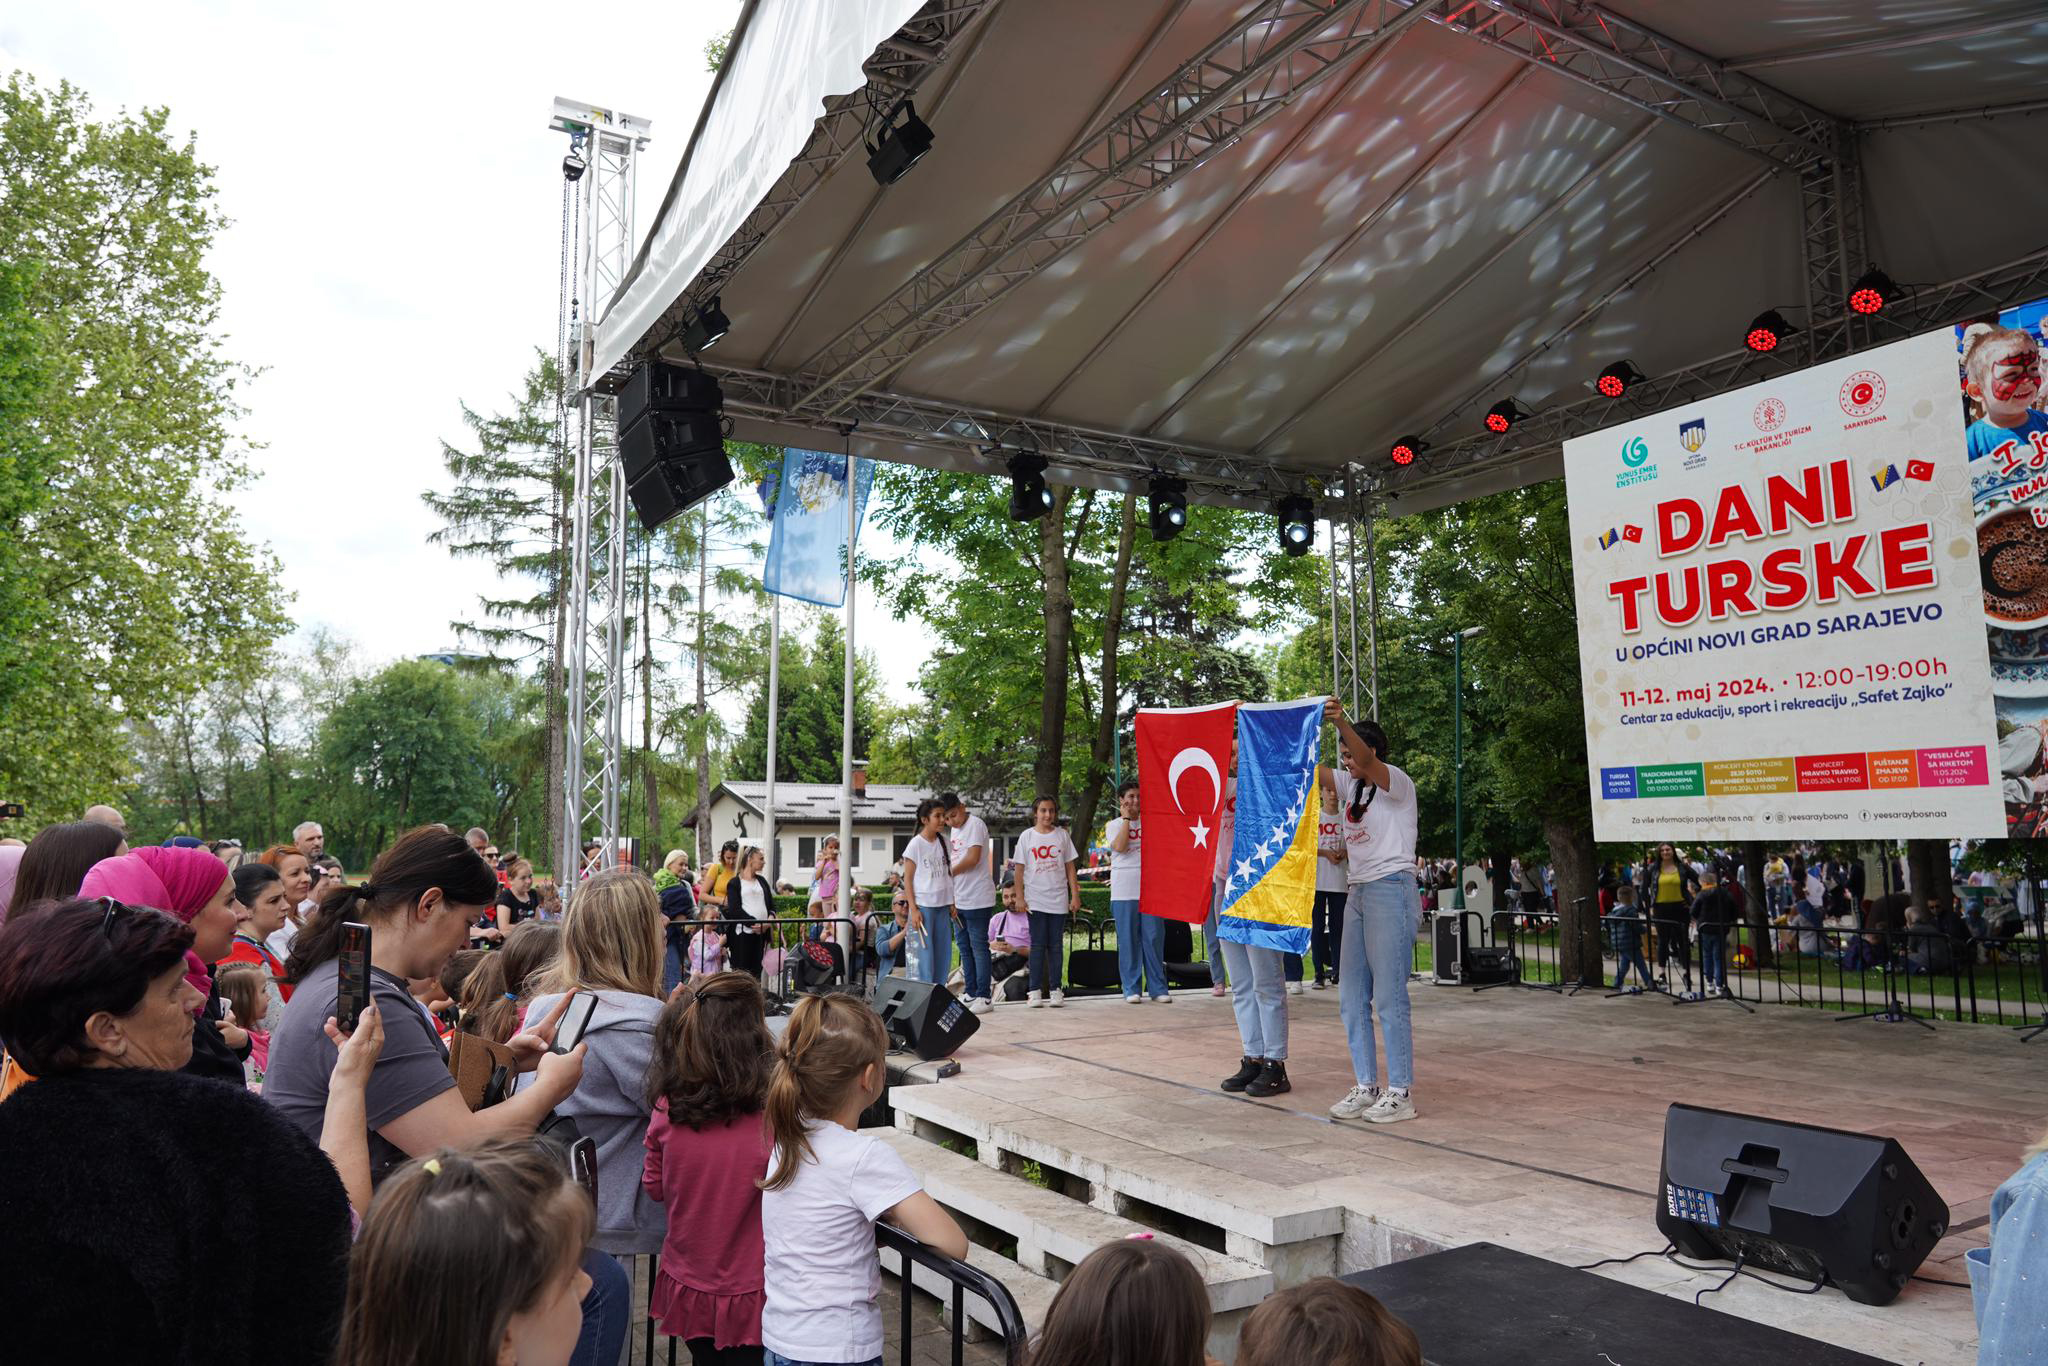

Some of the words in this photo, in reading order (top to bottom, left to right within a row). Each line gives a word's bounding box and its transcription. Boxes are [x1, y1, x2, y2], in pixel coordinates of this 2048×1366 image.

[1843, 414, 1887, 430] SARAYBOSNA
[1746, 435, 1773, 448] KÜLTÜR
[1774, 432, 1783, 440] VE
[1754, 438, 1792, 454] BAKANLIĞI
[1616, 468, 1638, 481] YUNUS
[1640, 464, 1657, 476] EMRE
[1656, 458, 1854, 556] DANI
[1608, 522, 1936, 632] TURSKE
[1616, 647, 1628, 662] U
[1632, 636, 1693, 660] OPĆINI
[1698, 632, 1746, 652] NOVI
[1751, 622, 1812, 644] GRAD
[1816, 602, 1943, 636] SARAJEVO
[1620, 688, 1670, 707] 11-12.
[1677, 684, 1711, 704] maj
[1718, 677, 1774, 698] 2024.
[1620, 712, 1658, 726] Centar
[1660, 712, 1673, 723] za
[1676, 704, 1735, 721] edukaciju,
[1738, 702, 1772, 717] sport
[1774, 700, 1778, 712] i
[1781, 694, 1848, 713] rekreaciju
[1813, 760, 1844, 768] KONCERT
[1875, 767, 1909, 775] ZMAJEVA
[1927, 760, 1938, 768] SA
[1939, 759, 1974, 768] KIKETOM
[1831, 768, 1859, 776] TRAVKO
[1656, 816, 1694, 825] informacija
[1696, 815, 1726, 825] posjetite
[1788, 812, 1848, 822] yeesaraybosna
[1873, 810, 1947, 820] yeesaraybosnaa
